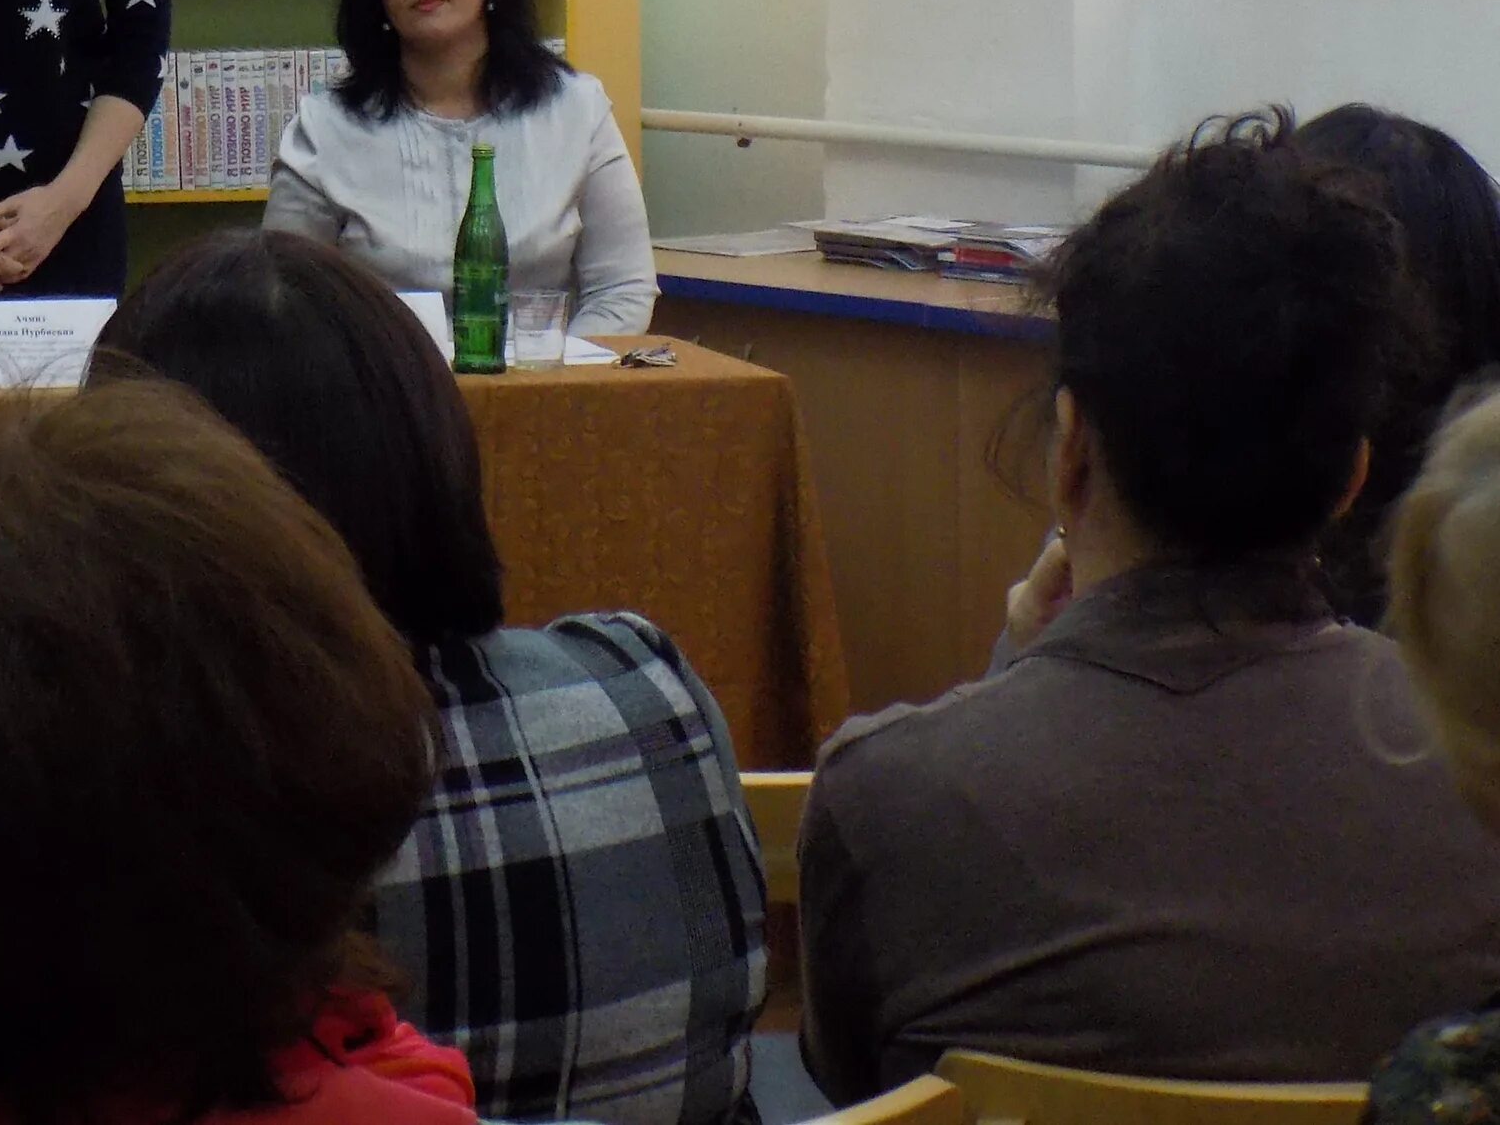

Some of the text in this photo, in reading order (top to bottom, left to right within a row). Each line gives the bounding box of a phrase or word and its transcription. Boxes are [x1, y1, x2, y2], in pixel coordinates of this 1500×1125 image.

[225, 87, 236, 112] МИР
[239, 87, 250, 112] МИР
[226, 116, 237, 164] ПОЗНАЮ
[241, 115, 251, 164] ПОЗНАЮ
